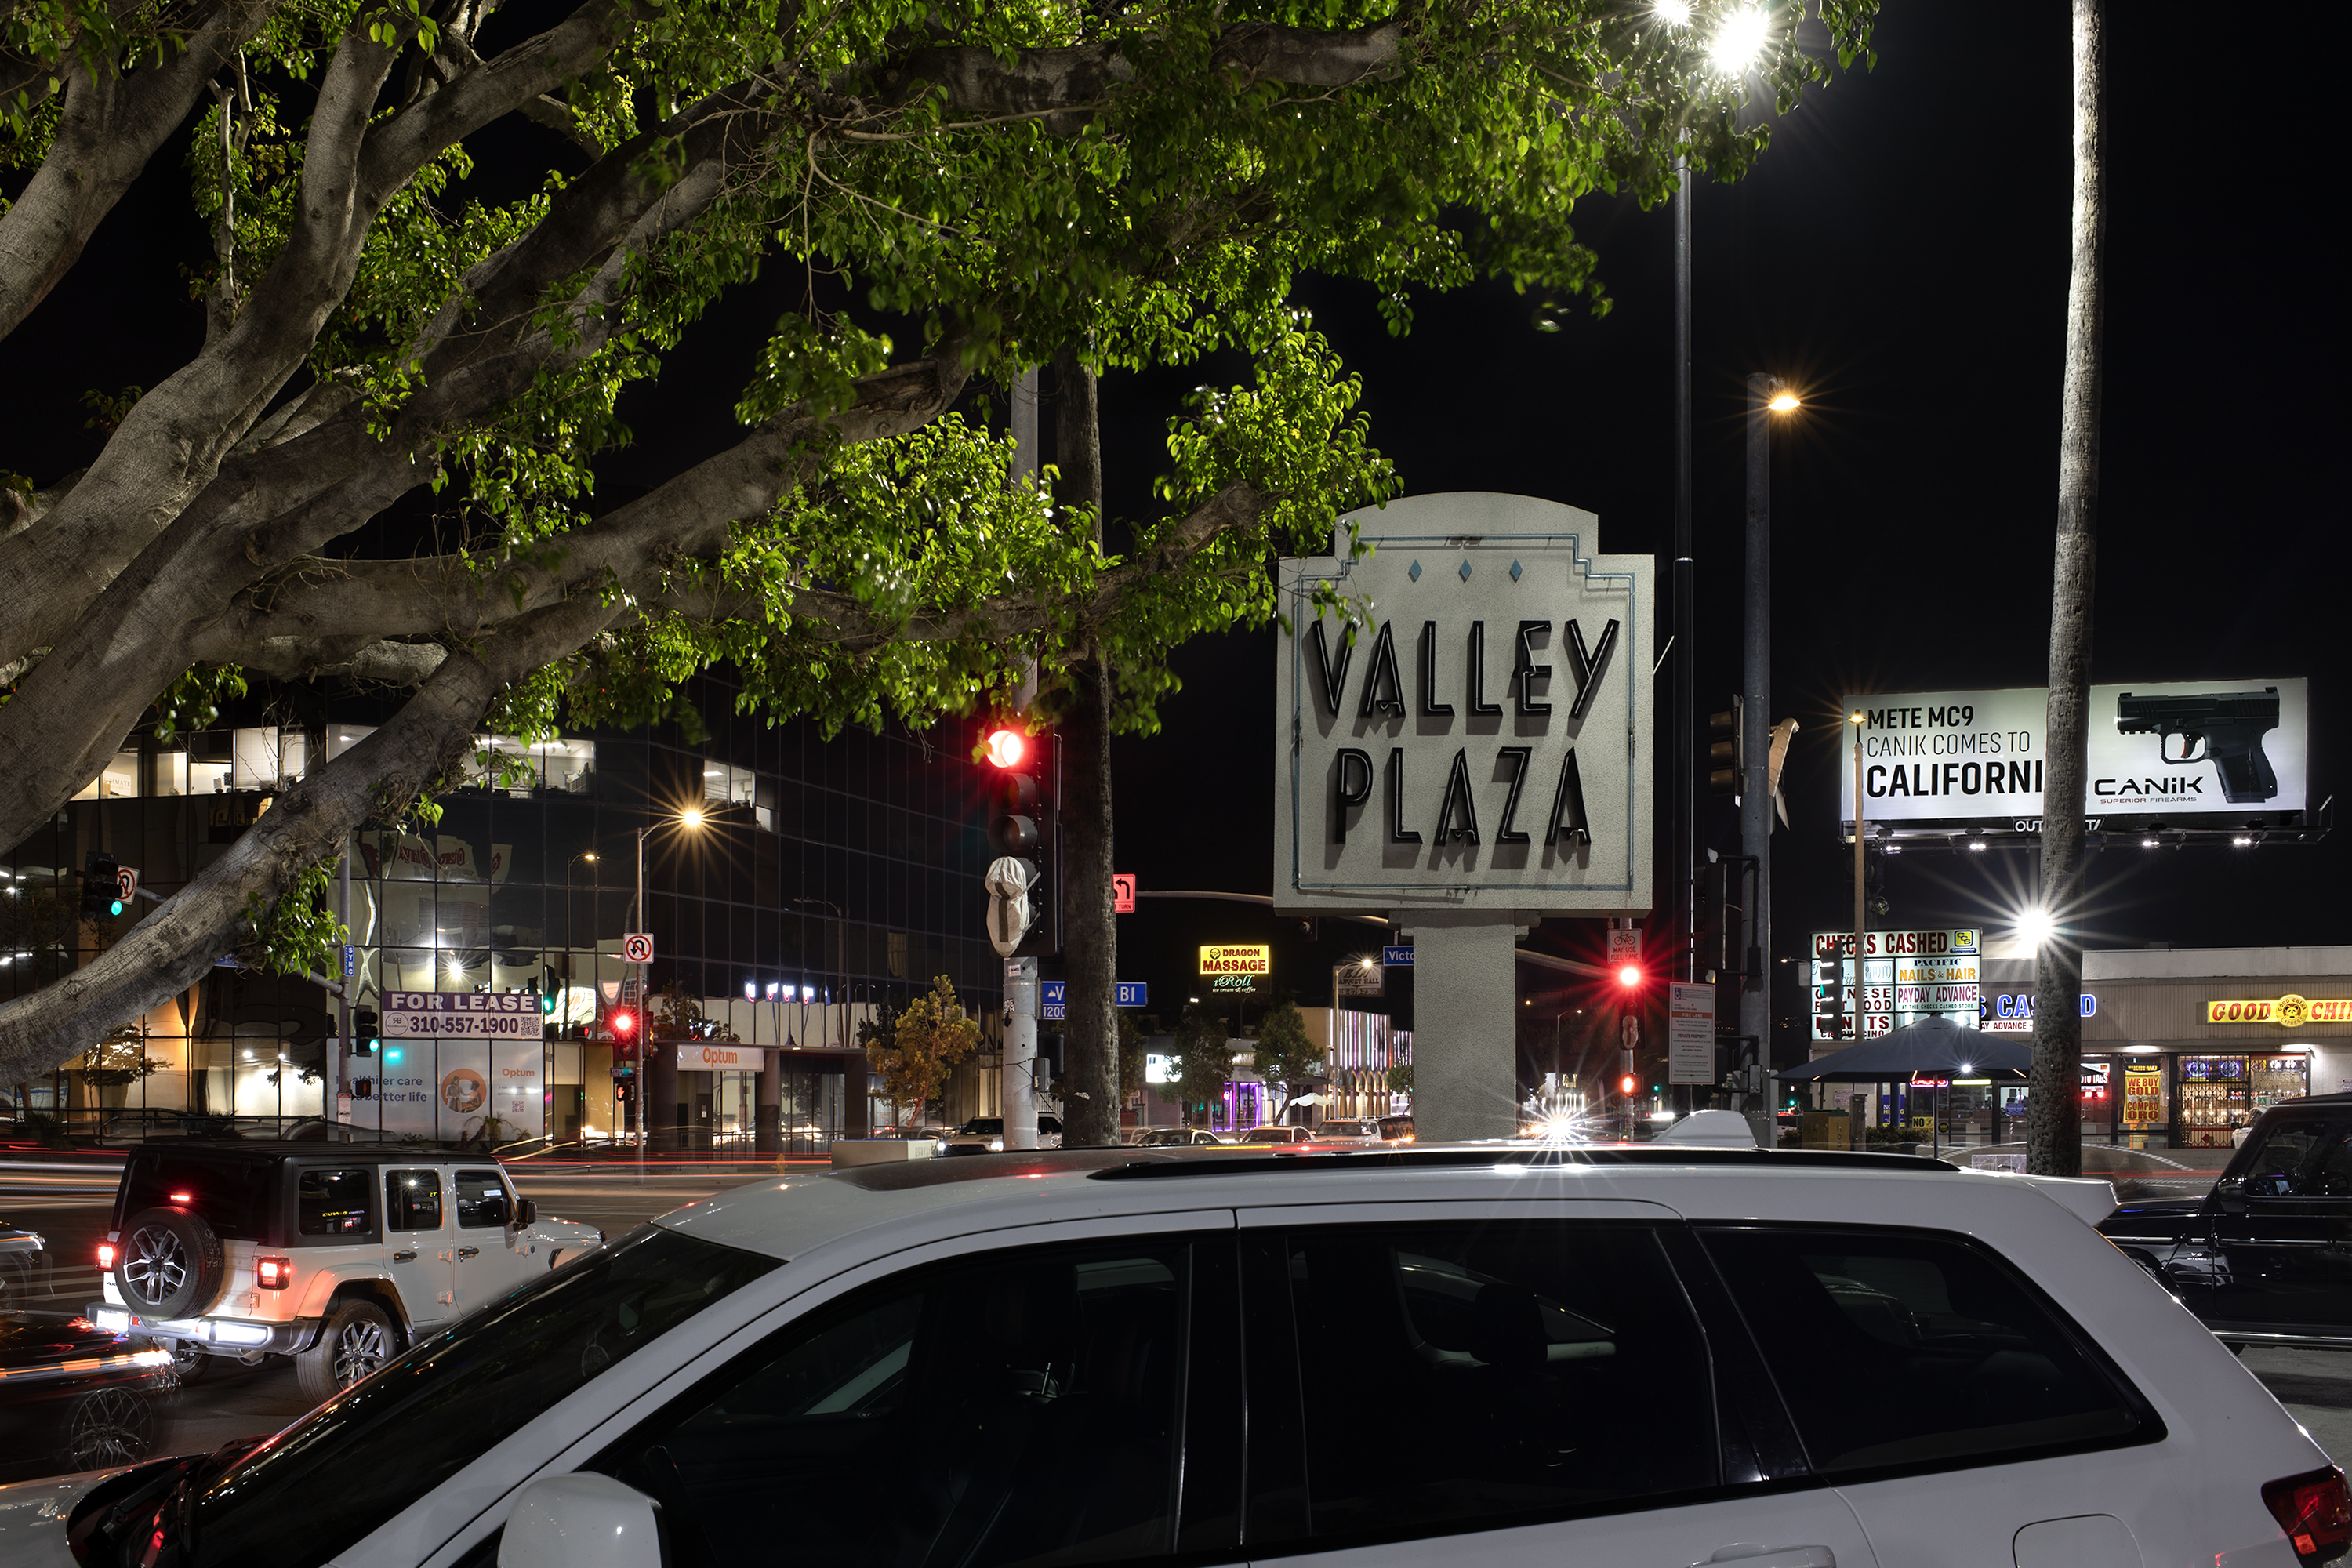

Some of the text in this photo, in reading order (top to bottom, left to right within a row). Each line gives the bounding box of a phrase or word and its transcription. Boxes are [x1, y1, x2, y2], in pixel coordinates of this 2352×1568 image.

[1312, 618, 1621, 718] VALLEY
[1867, 705, 1974, 730] METE MC9
[1867, 731, 2030, 757] CANIK COMES TO
[1867, 760, 2042, 798] CALIFORNI
[1335, 746, 1591, 846] PLAZA
[1816, 932, 1947, 955] CHCS CASHED
[1203, 960, 1265, 971] MASSAGE
[1899, 968, 1936, 981] NAILS
[1946, 968, 1976, 980] HAIR
[1897, 985, 1977, 1003] PAYDAY ADVANCE
[392, 993, 535, 1011] FOR LEASE
[1864, 1000, 1891, 1011] OOD
[2212, 1003, 2271, 1021] GOOD
[409, 1016, 519, 1033] 310-557-1900
[1993, 1022, 2027, 1030] ADVANCE
[2280, 1016, 2304, 1025] EXPRESS
[702, 1047, 738, 1068] Optum
[502, 1068, 535, 1078] Optum
[2127, 1078, 2158, 1087] WE BUY
[365, 1092, 407, 1102] better
[409, 1091, 427, 1102] life
[2127, 1087, 2158, 1095] GOLD
[1913, 1118, 1924, 1127] NO
[2127, 1111, 2158, 1120] ORO
